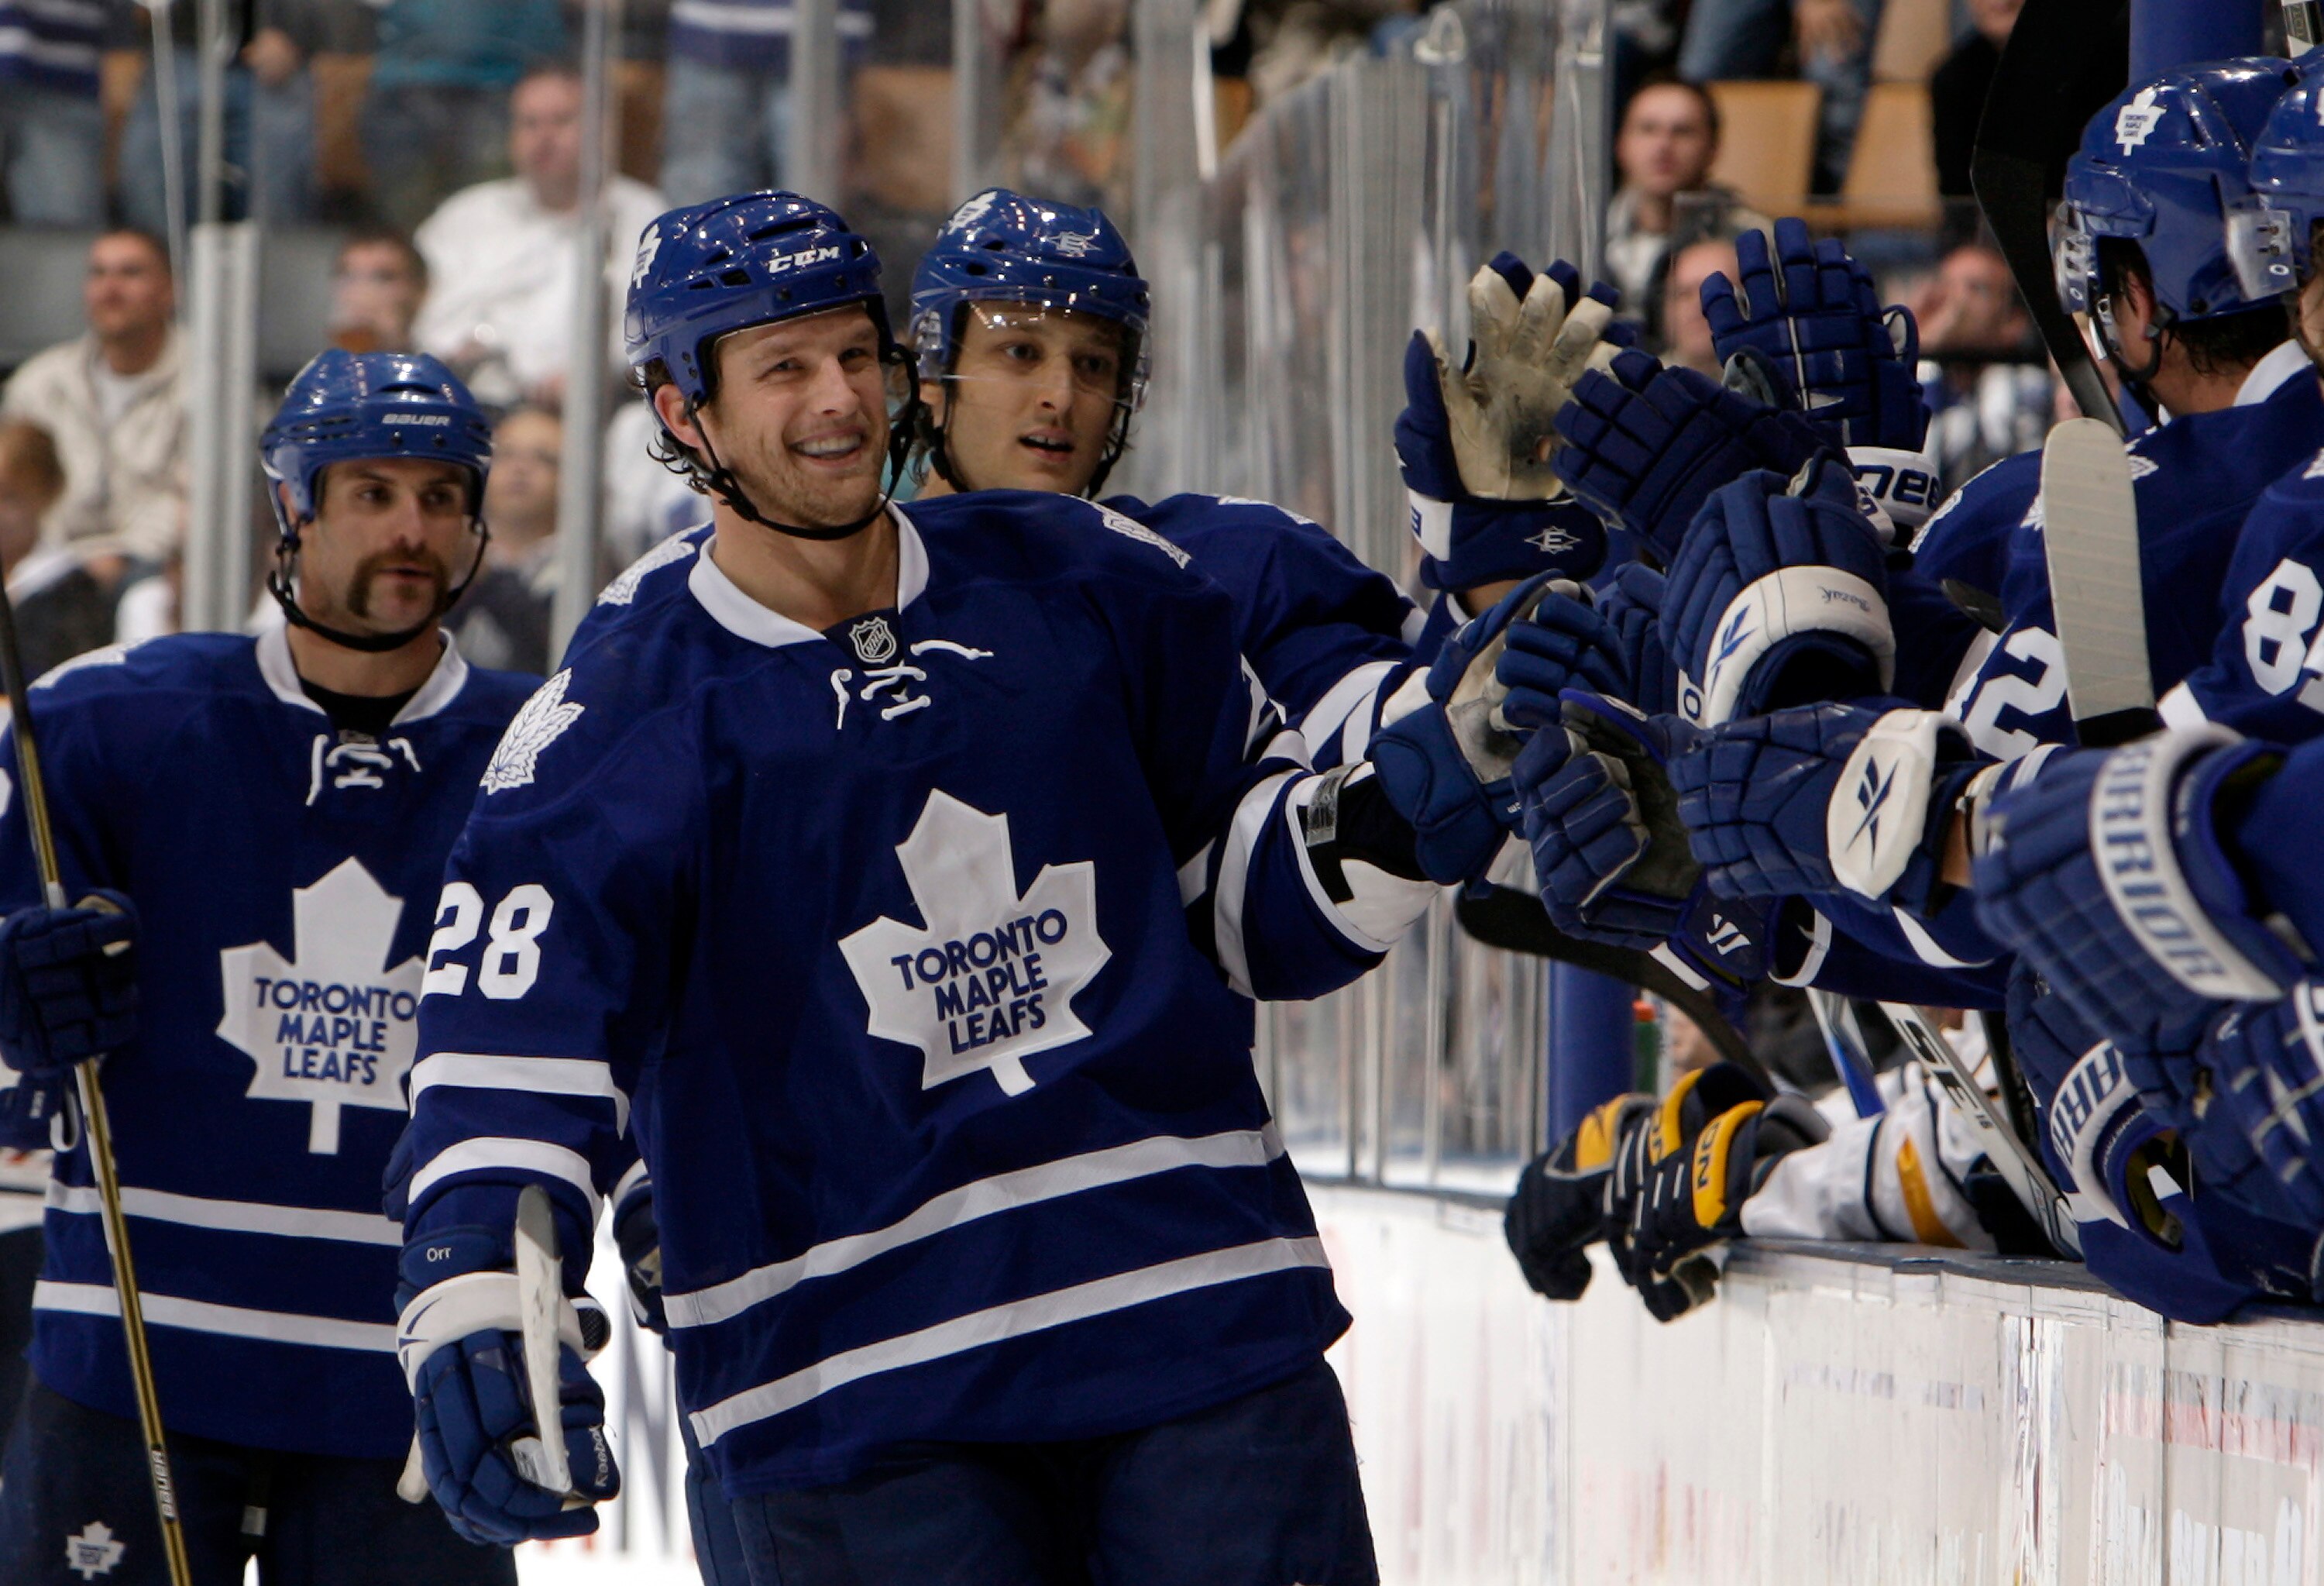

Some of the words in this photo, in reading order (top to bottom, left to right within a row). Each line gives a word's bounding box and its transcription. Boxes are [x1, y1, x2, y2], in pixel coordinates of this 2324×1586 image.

[768, 246, 839, 274] CCM
[382, 413, 450, 426] BAUER
[418, 881, 555, 999] 28
[891, 909, 1068, 990] TORONTO
[254, 977, 418, 1021] TORONTO
[934, 952, 1048, 1022] MAPLE
[277, 1013, 387, 1052] MAPLE
[947, 993, 1046, 1054] LEAFS
[284, 1046, 378, 1085] LEAFS
[427, 1247, 452, 1262] Orr
